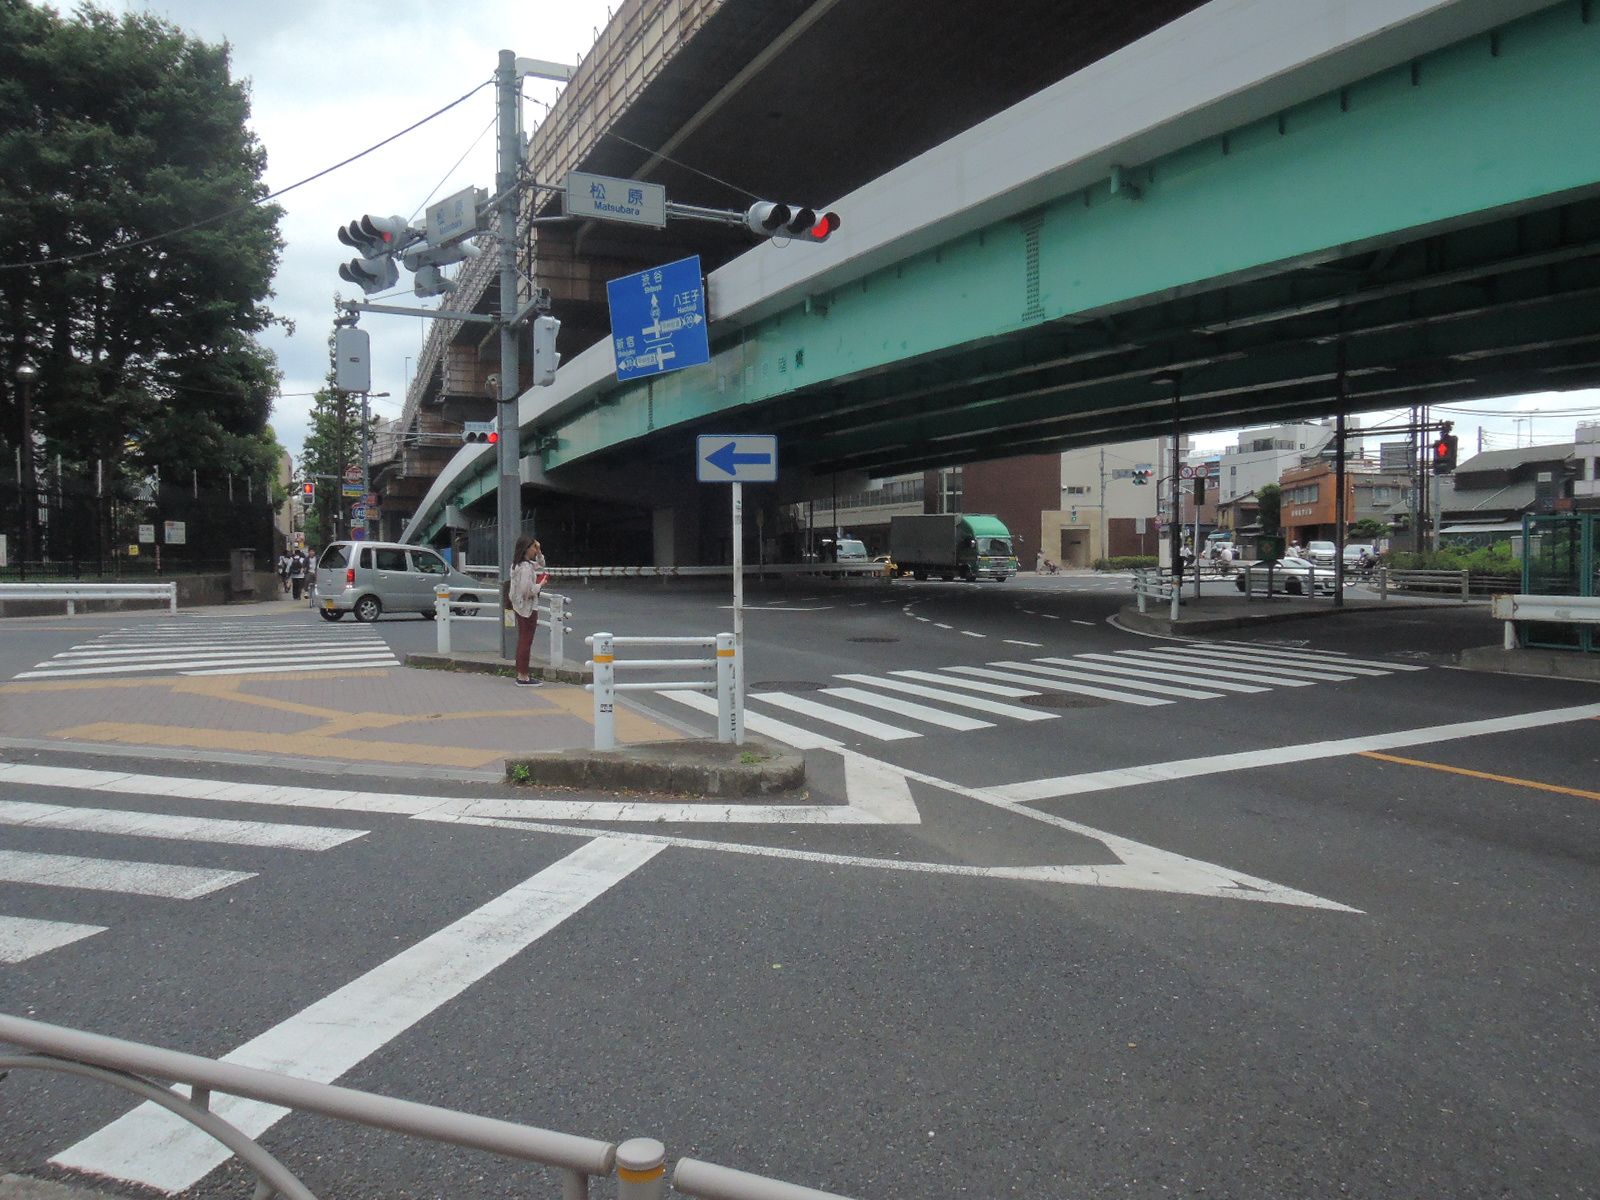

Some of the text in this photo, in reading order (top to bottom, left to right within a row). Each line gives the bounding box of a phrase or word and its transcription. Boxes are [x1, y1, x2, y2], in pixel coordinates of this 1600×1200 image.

[590, 181, 643, 206] 松原
[594, 200, 641, 216] Matsubara
[641, 270, 662, 287] 渋谷
[673, 289, 699, 308] 八王子
